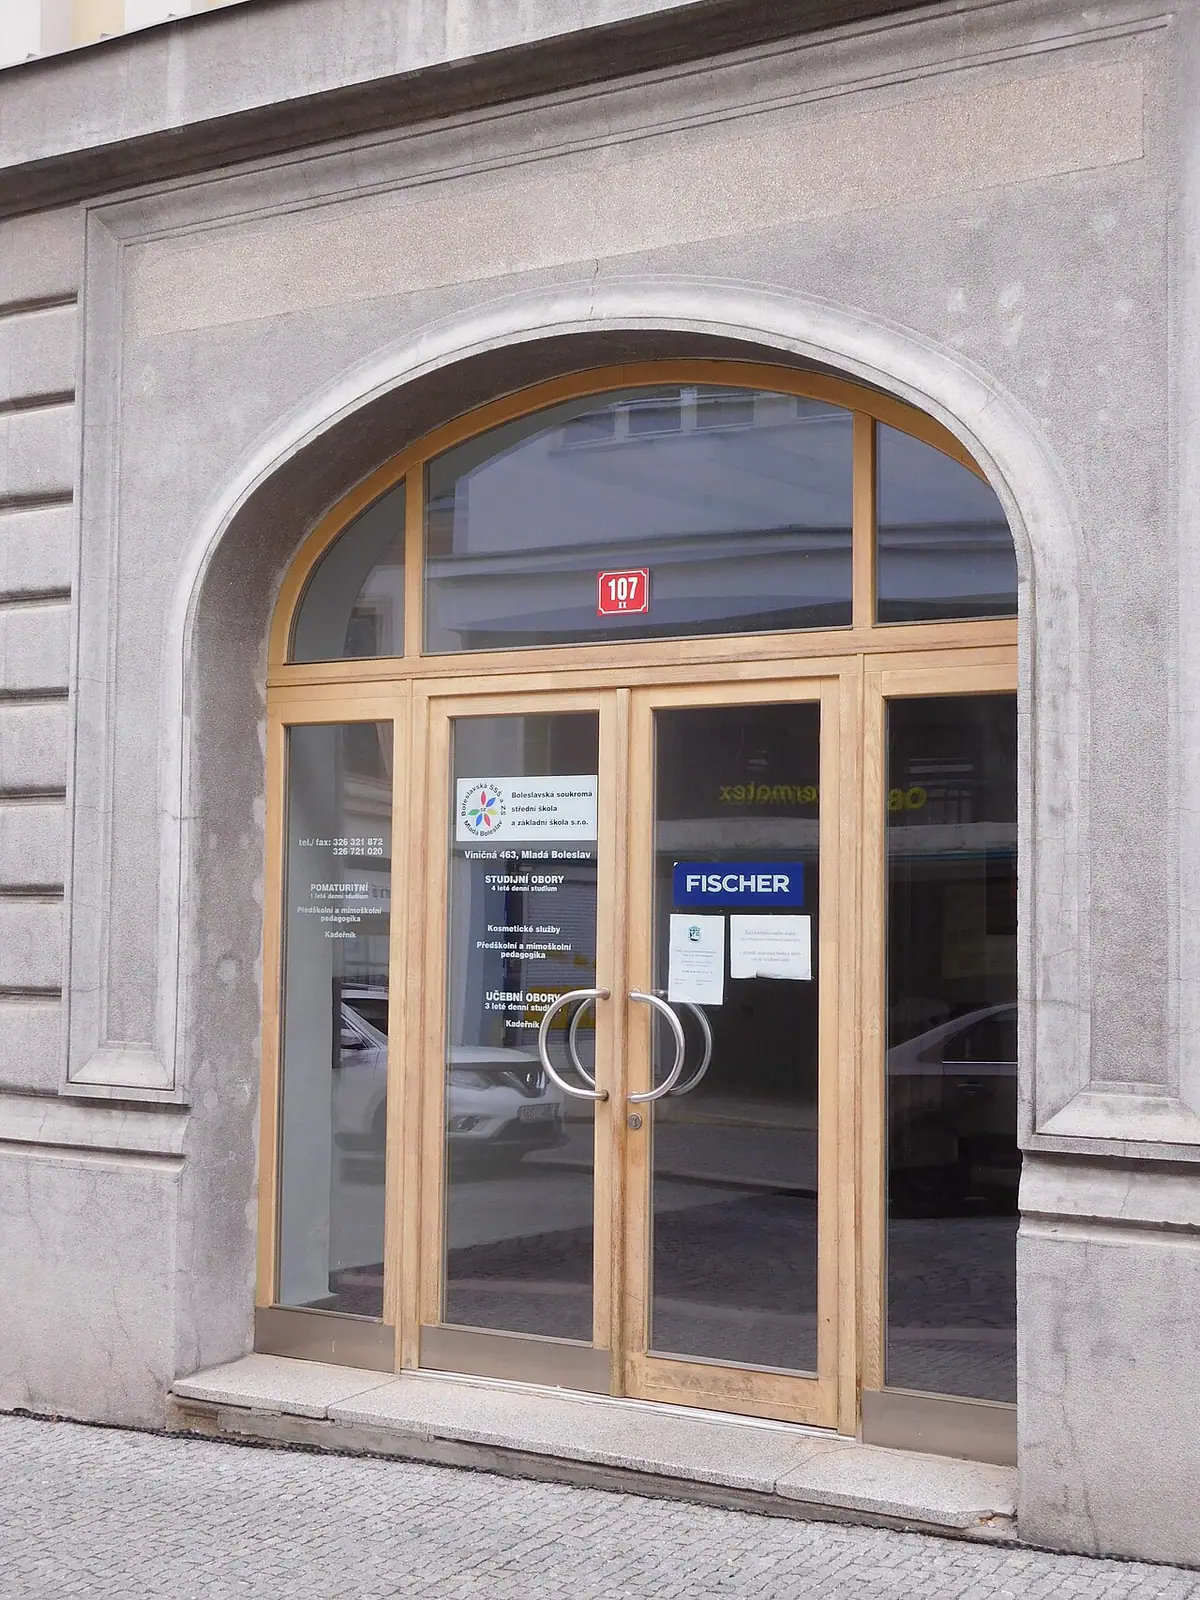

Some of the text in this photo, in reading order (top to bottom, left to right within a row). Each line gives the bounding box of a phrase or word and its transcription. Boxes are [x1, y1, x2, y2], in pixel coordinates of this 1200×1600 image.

[608, 576, 638, 601] 107
[511, 789, 593, 799] Boleslavská soukromá
[511, 804, 558, 812] střední škola
[464, 820, 503, 836] Mladá Boleslav
[315, 838, 331, 846] fax:
[333, 838, 348, 846] 326
[350, 838, 365, 846] 321
[367, 837, 384, 846] 872
[333, 847, 383, 856] 326 721 020
[464, 850, 592, 860] Viničná 463, Mladá Boleslav
[484, 873, 565, 884] STUDIJNÍ OBORY
[686, 874, 790, 893] FISCHER
[310, 882, 369, 892] POMATURITNÍ
[297, 905, 334, 914] Předškolní
[341, 906, 382, 914] mimoškolní
[320, 914, 361, 923] pedagogika
[324, 930, 357, 939] Kadeřník
[487, 924, 561, 935] Kosmetické služby
[476, 941, 518, 949] Předškolní
[525, 942, 572, 951] mimoškolní
[500, 951, 546, 960] pedagogika
[485, 990, 561, 1003] UČEBNÍ OBORY
[484, 1002, 490, 1010] 3
[491, 1002, 506, 1010] leté
[507, 1002, 529, 1011] denní
[505, 1019, 540, 1029] Kadeřník
